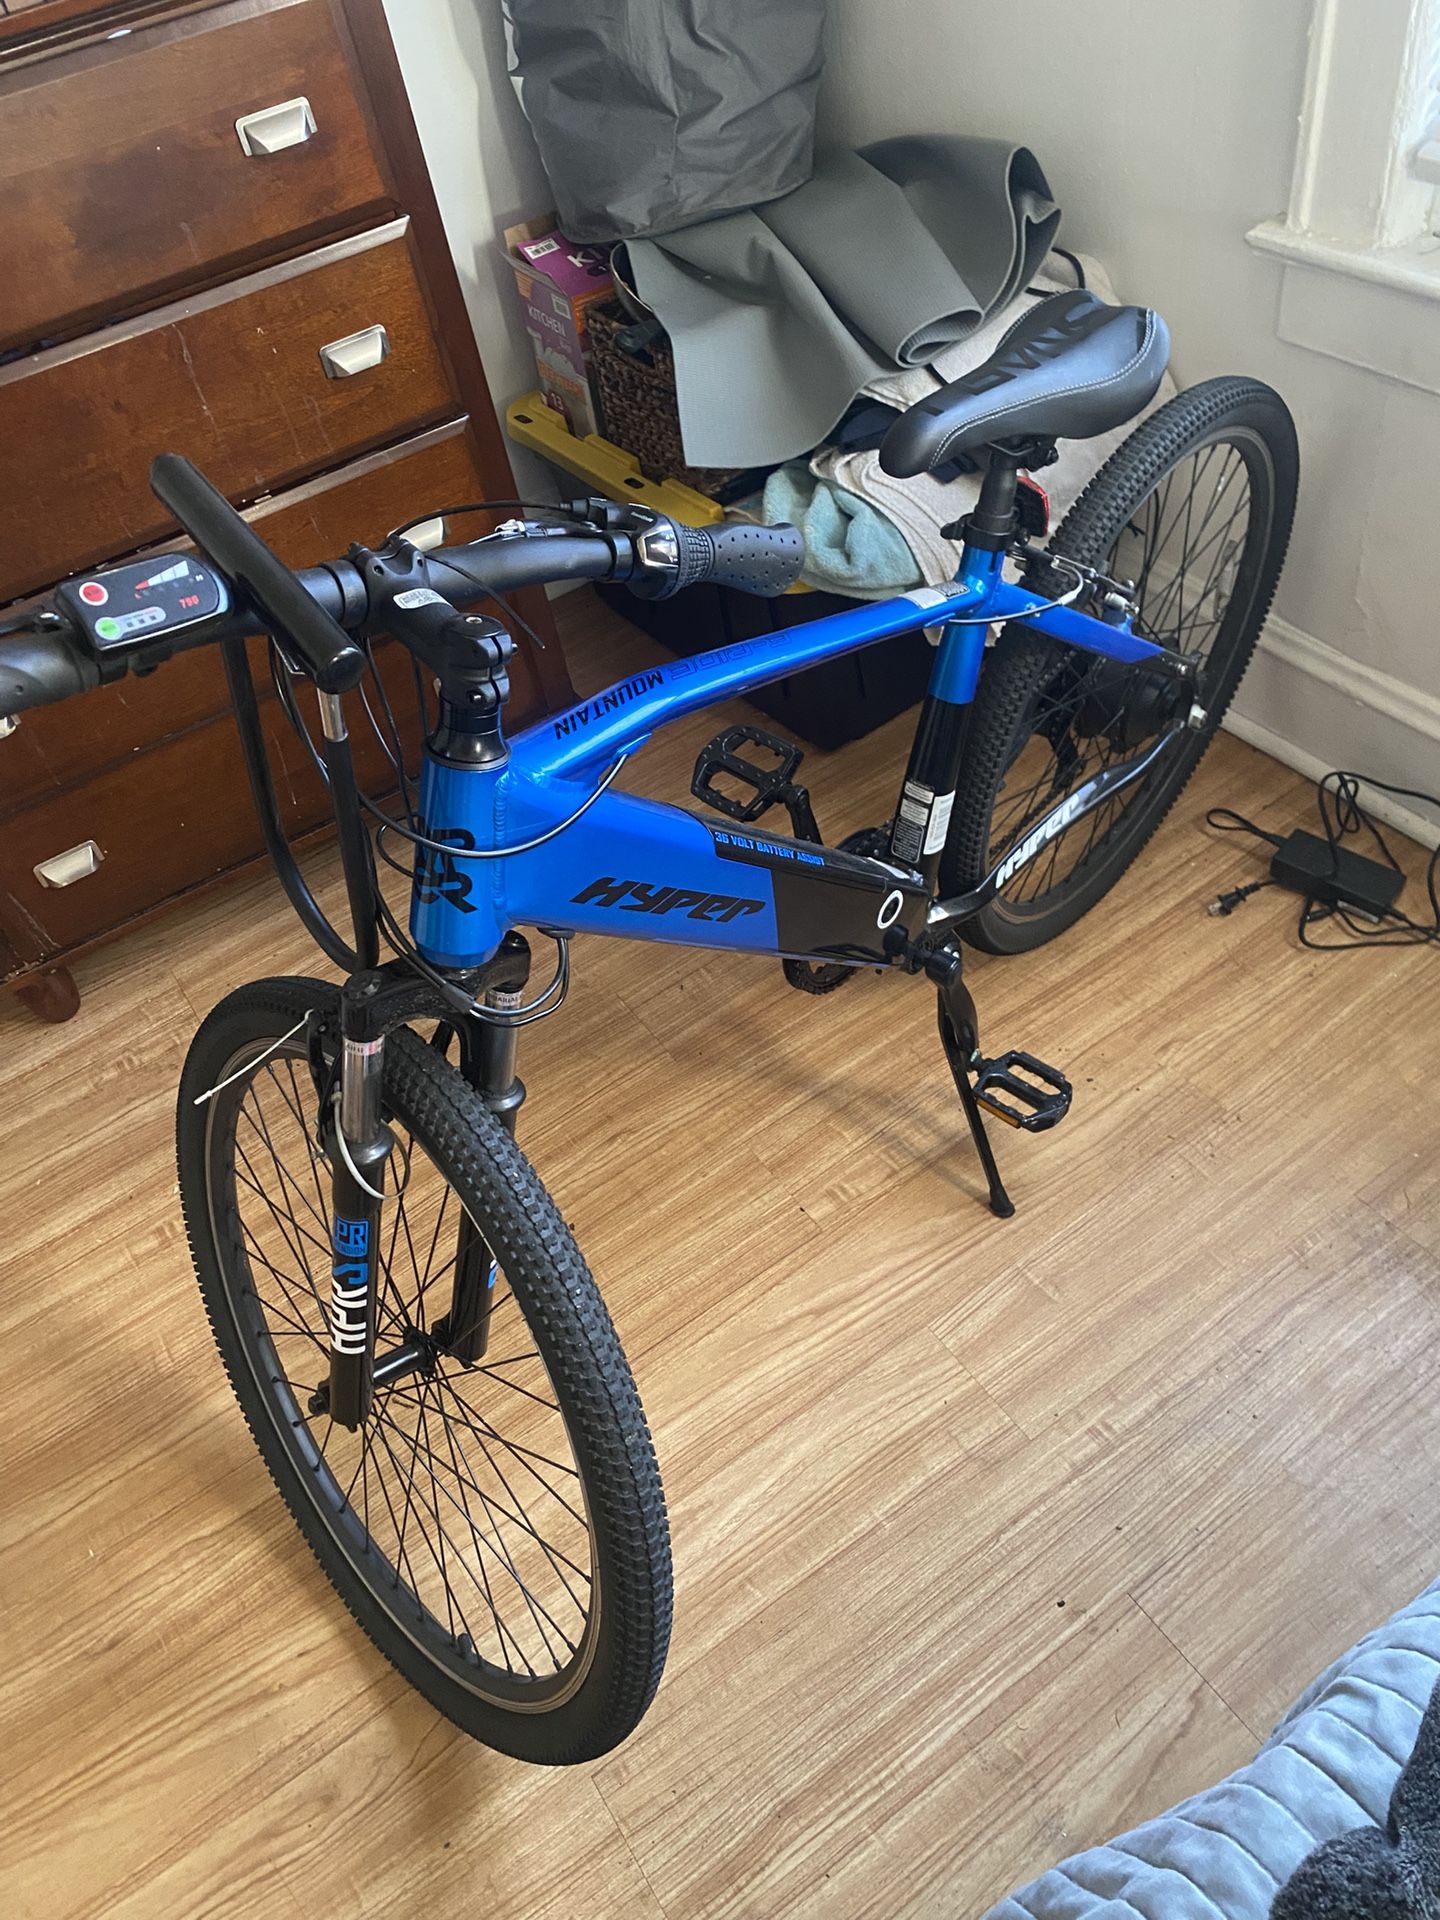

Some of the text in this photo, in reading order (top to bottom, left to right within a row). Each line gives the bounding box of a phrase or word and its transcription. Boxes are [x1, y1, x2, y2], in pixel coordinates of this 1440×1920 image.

[527, 304, 566, 336] KITCHEN
[551, 392, 564, 410] 13
[553, 670, 664, 740] MOUNTAIN
[714, 831, 729, 844] 36
[731, 835, 754, 850] VOLT
[756, 842, 795, 859] BATTERY
